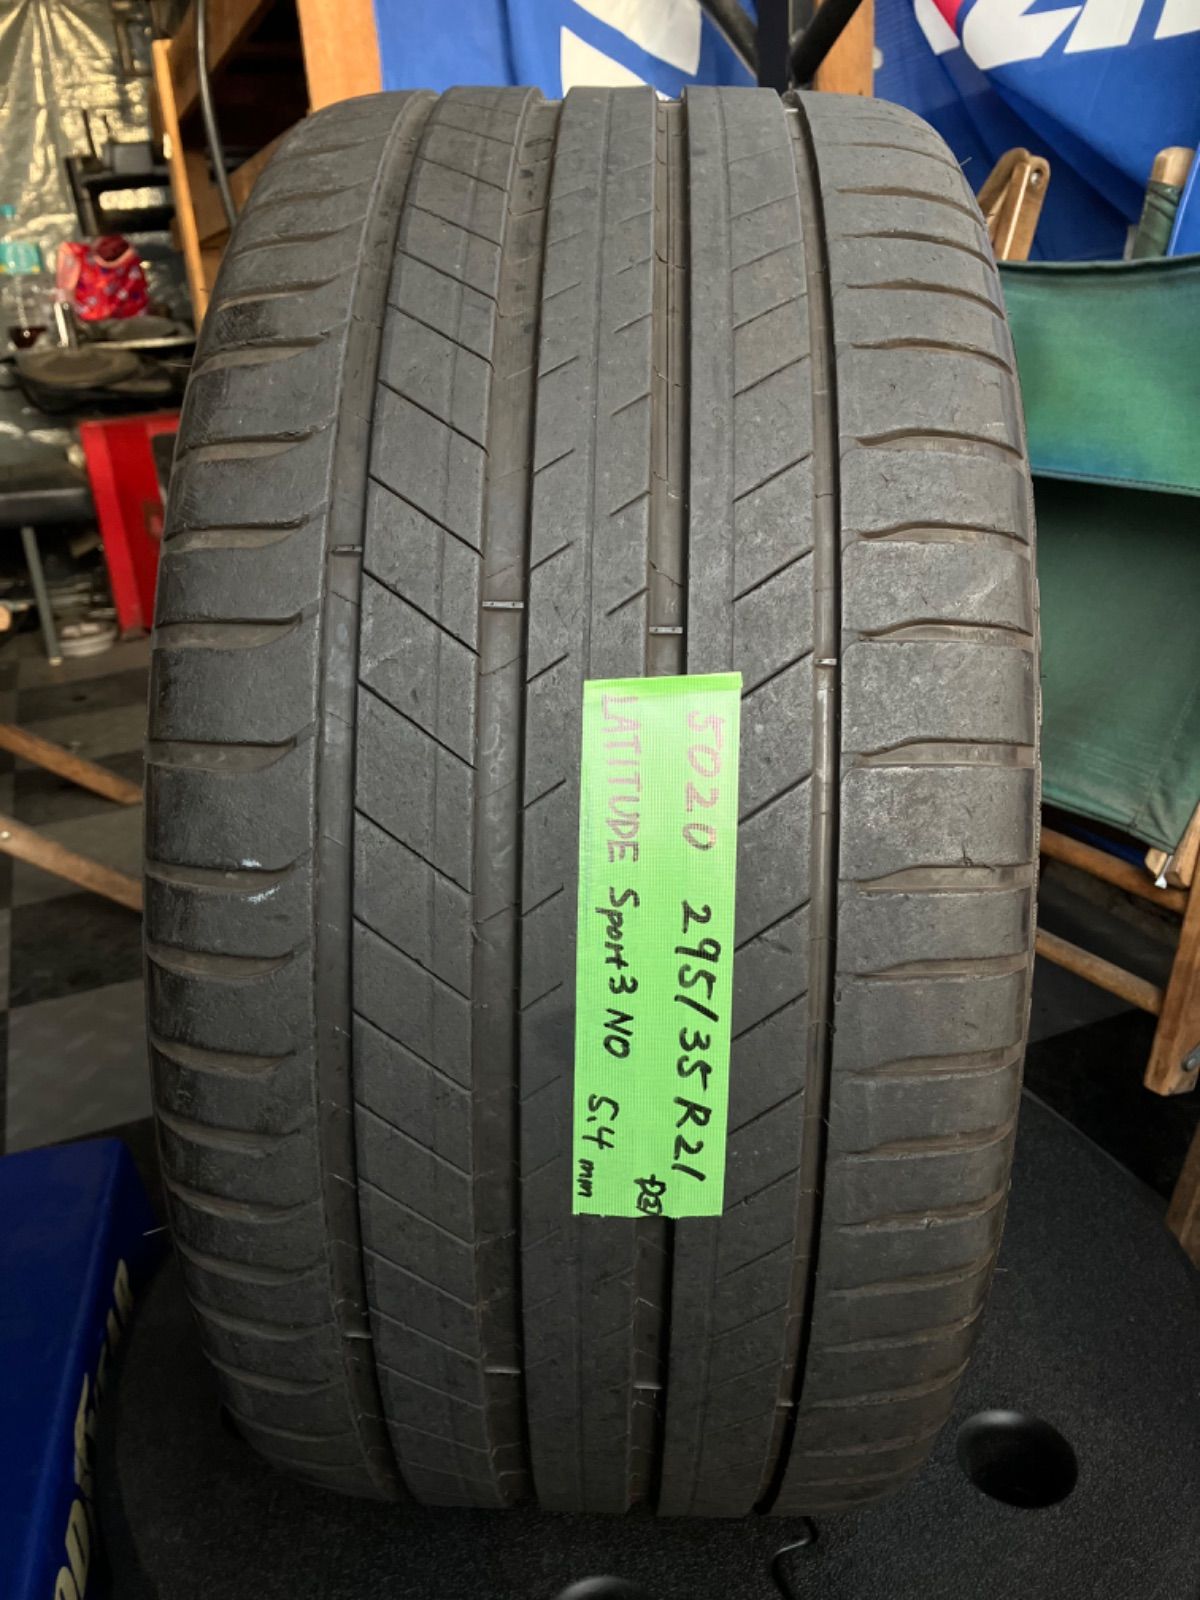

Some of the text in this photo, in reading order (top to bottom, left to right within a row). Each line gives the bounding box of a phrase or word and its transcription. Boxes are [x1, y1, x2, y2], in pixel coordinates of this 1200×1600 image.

[602, 694, 641, 863] LATITUDE
[682, 709, 725, 851] 5020
[582, 1093, 620, 1151] 5.4
[577, 1157, 595, 1199] mm
